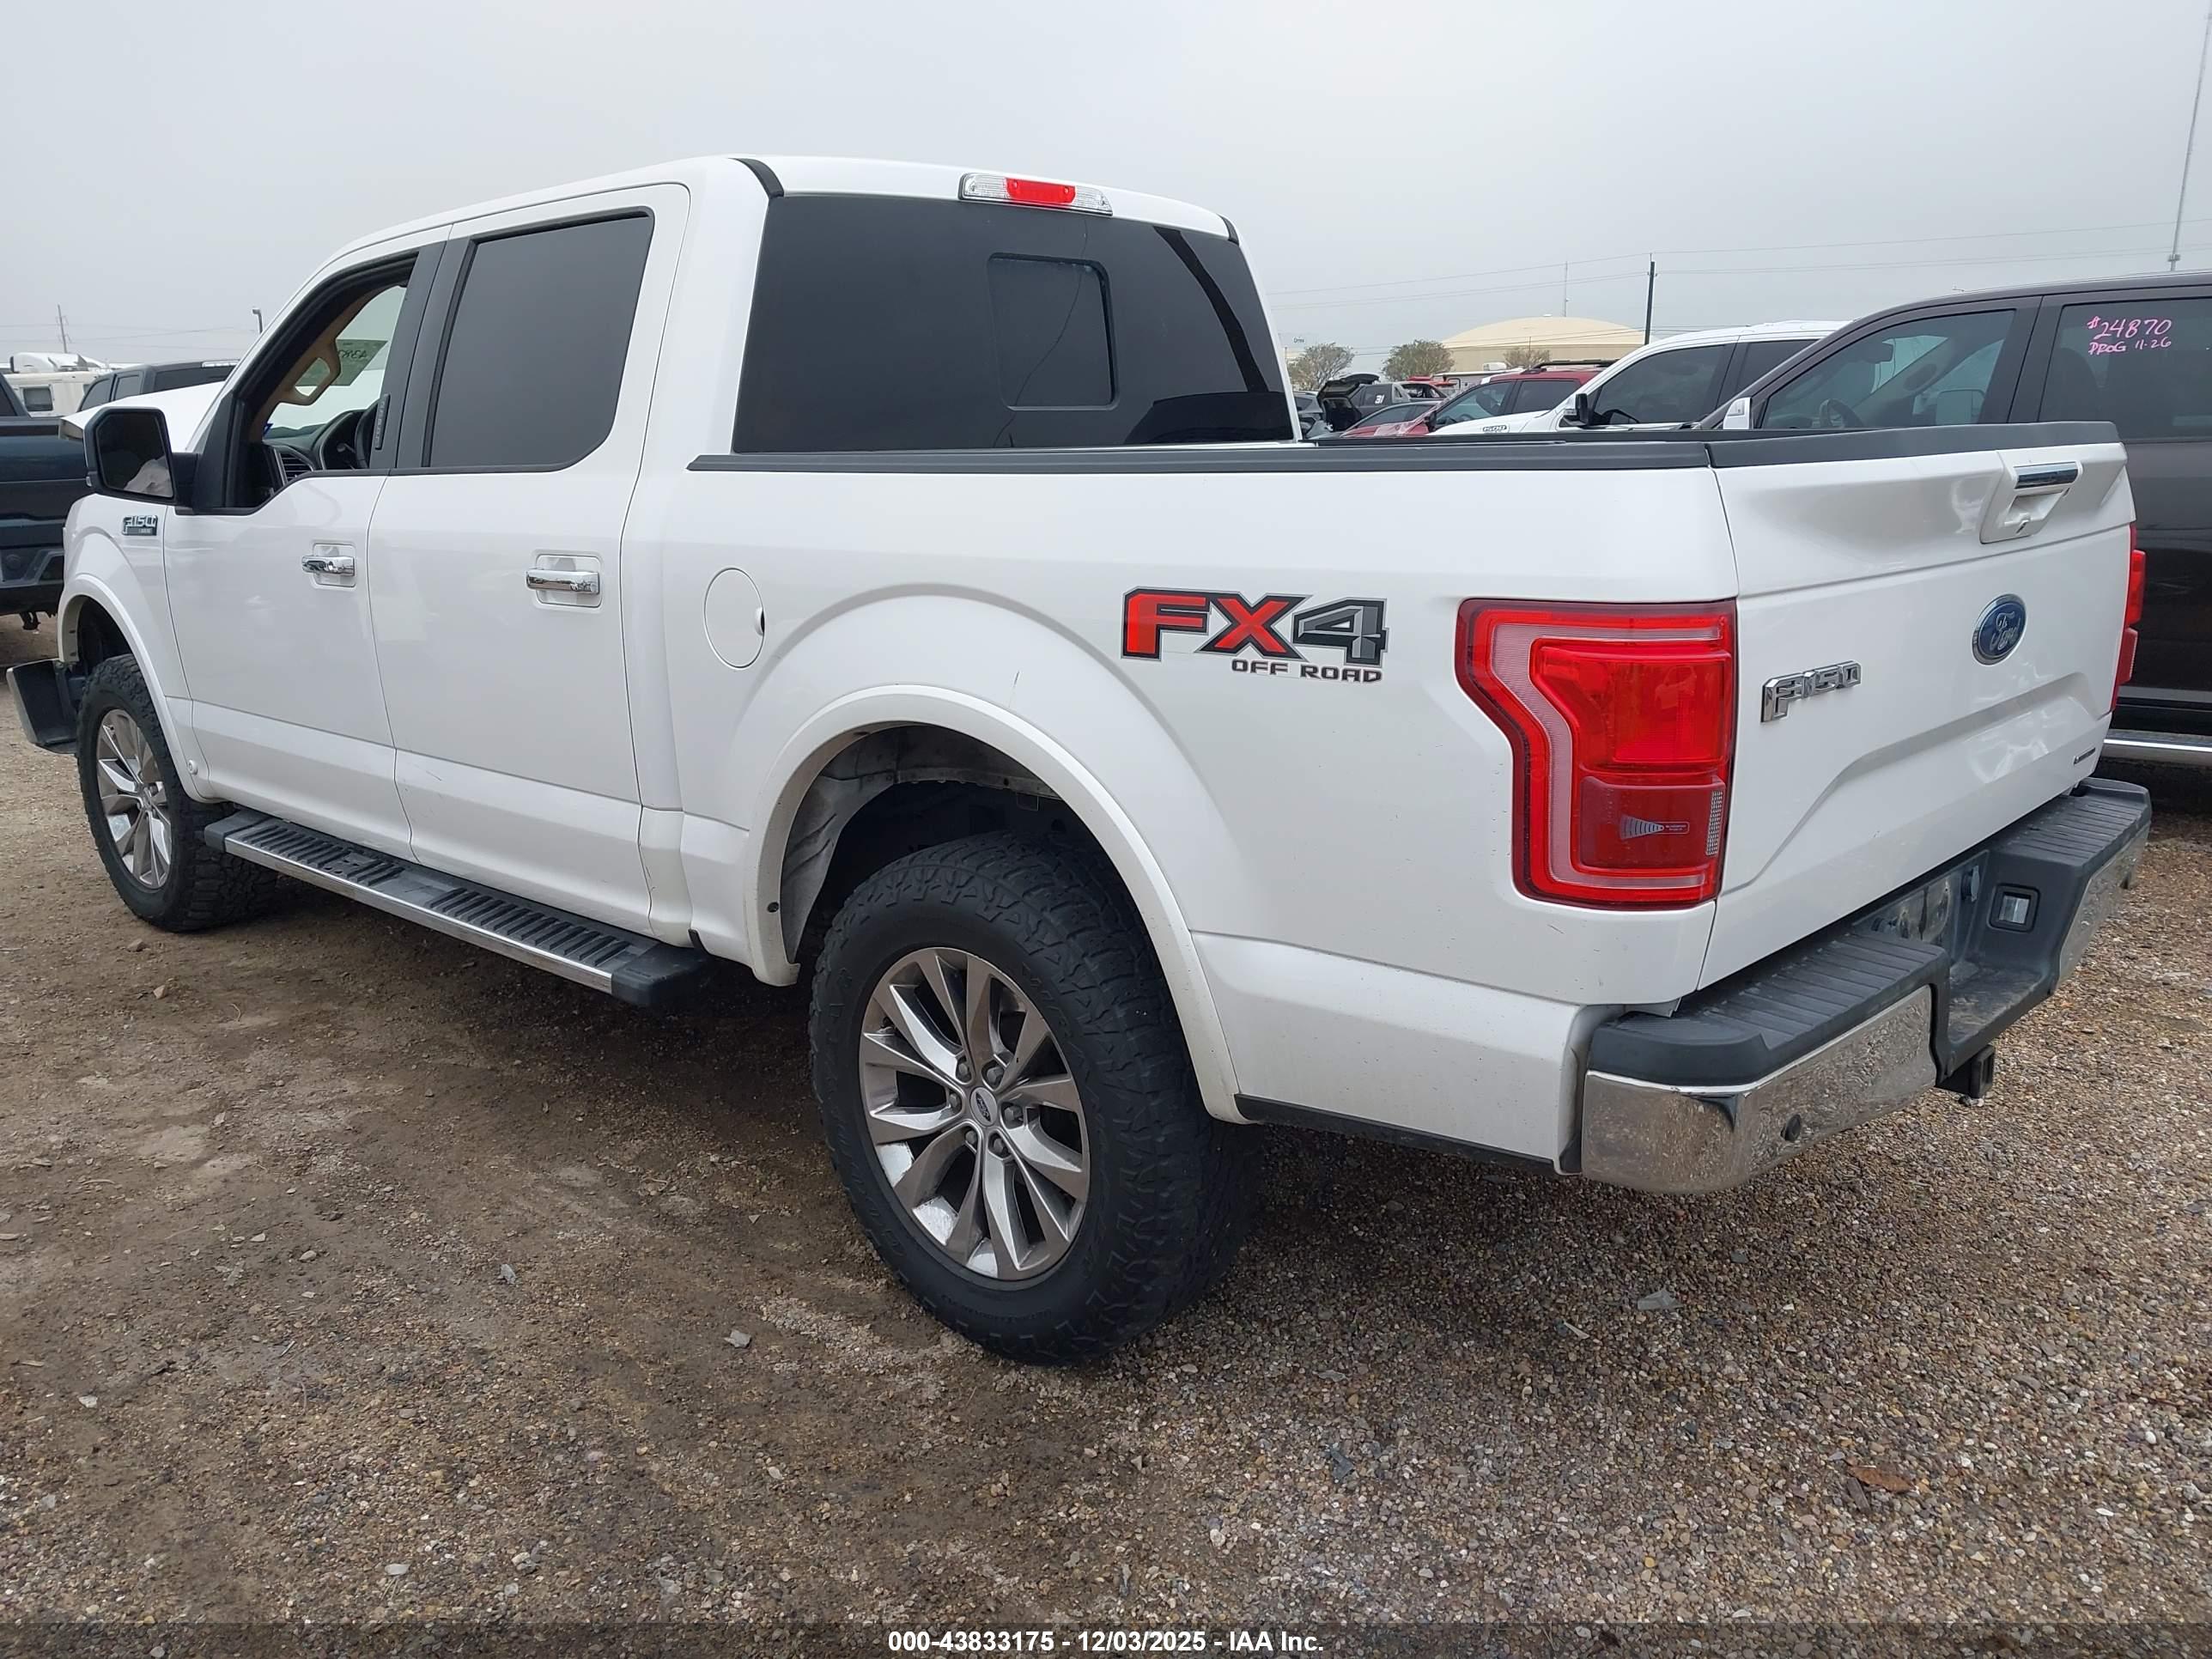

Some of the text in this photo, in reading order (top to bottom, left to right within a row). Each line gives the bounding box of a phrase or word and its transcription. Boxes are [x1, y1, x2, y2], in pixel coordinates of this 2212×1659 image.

[2087, 315, 2172, 340] $24870
[1121, 586, 1389, 666] FX4
[1231, 658, 1382, 684] OFF ROAD
